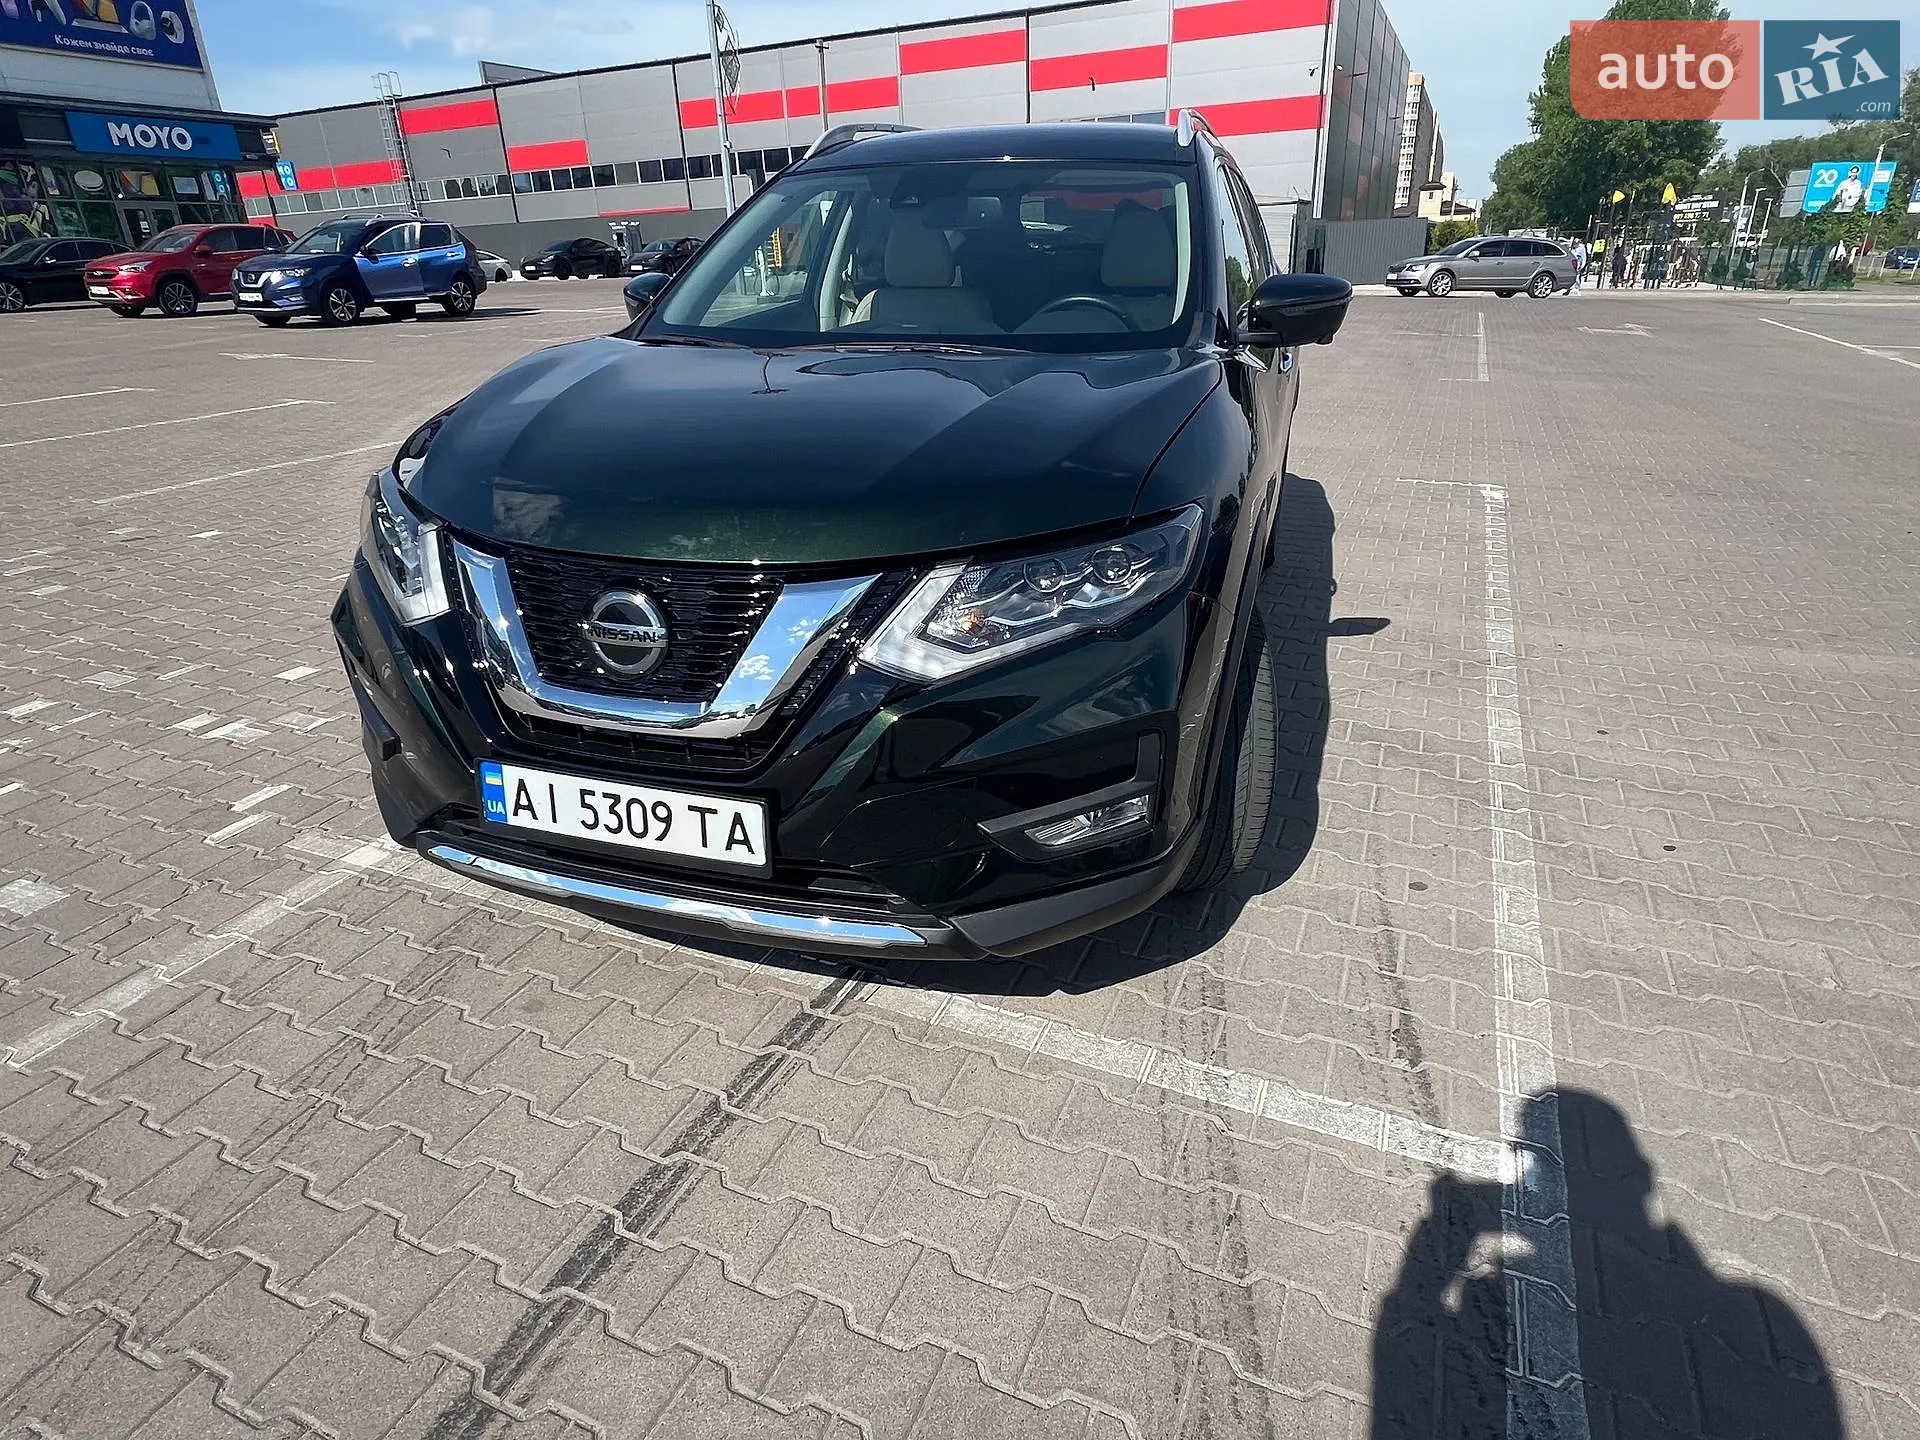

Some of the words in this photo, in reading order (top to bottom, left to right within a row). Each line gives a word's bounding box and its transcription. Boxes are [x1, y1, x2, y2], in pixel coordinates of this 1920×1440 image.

[54, 34, 92, 48] Кожен
[92, 42, 129, 54] знайде
[107, 122, 193, 151] MOYO
[1813, 168, 1838, 188] 20
[589, 626, 657, 643] NISSAN
[488, 799, 506, 814] UA
[579, 788, 673, 841] 5309
[687, 805, 755, 855] TA
